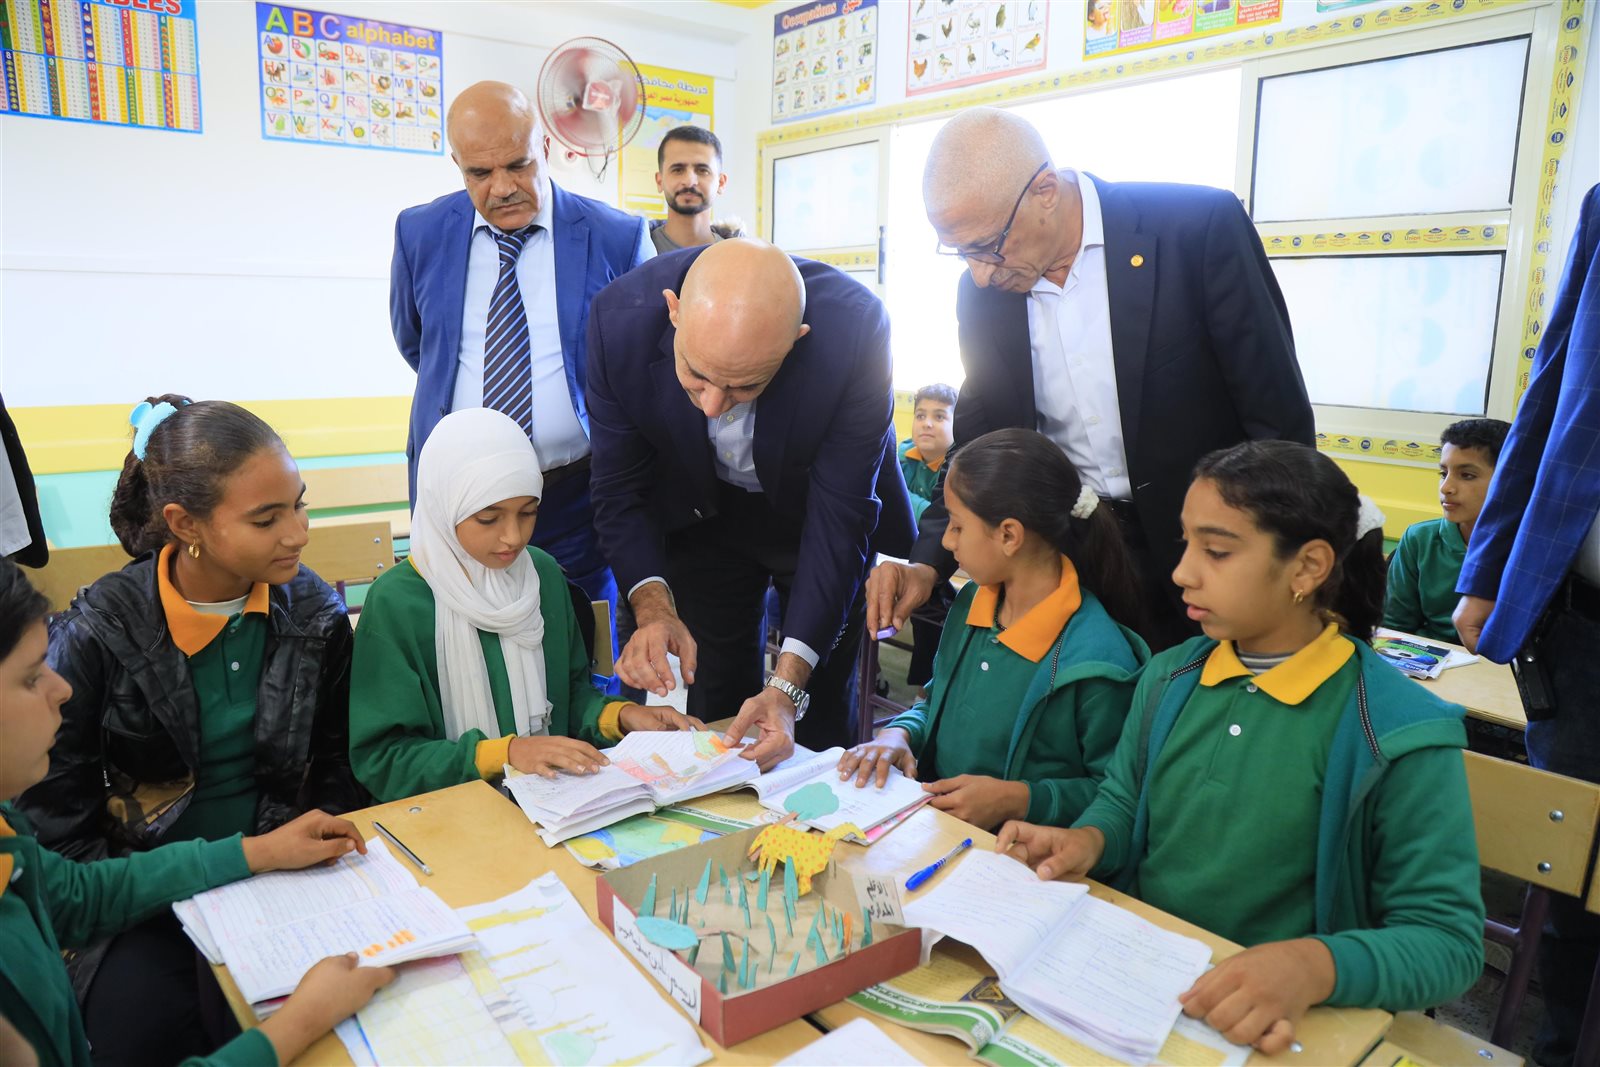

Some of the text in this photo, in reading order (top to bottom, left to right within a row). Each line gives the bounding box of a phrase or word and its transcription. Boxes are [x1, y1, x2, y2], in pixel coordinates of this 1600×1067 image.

[265, 7, 436, 50] A B C alphabet
[264, 35, 275, 45] A
[292, 39, 301, 49] B
[318, 42, 327, 52] C
[345, 45, 354, 56] D
[1562, 45, 1571, 65] Union
[264, 61, 274, 72] H
[296, 65, 299, 75] I
[345, 71, 354, 81] K
[371, 74, 378, 85] L
[394, 78, 404, 88] M
[419, 81, 428, 92] N
[678, 79, 708, 95] خريطة
[266, 87, 275, 97] O
[294, 90, 302, 100] P
[319, 93, 330, 105] Q
[346, 96, 355, 106] R
[419, 105, 428, 116] U
[267, 113, 276, 124] V
[293, 116, 306, 126] W
[321, 119, 330, 129] X
[348, 121, 355, 132] Y
[372, 124, 380, 134] Z
[1548, 158, 1556, 177] Union
[1522, 372, 1530, 390] Union
